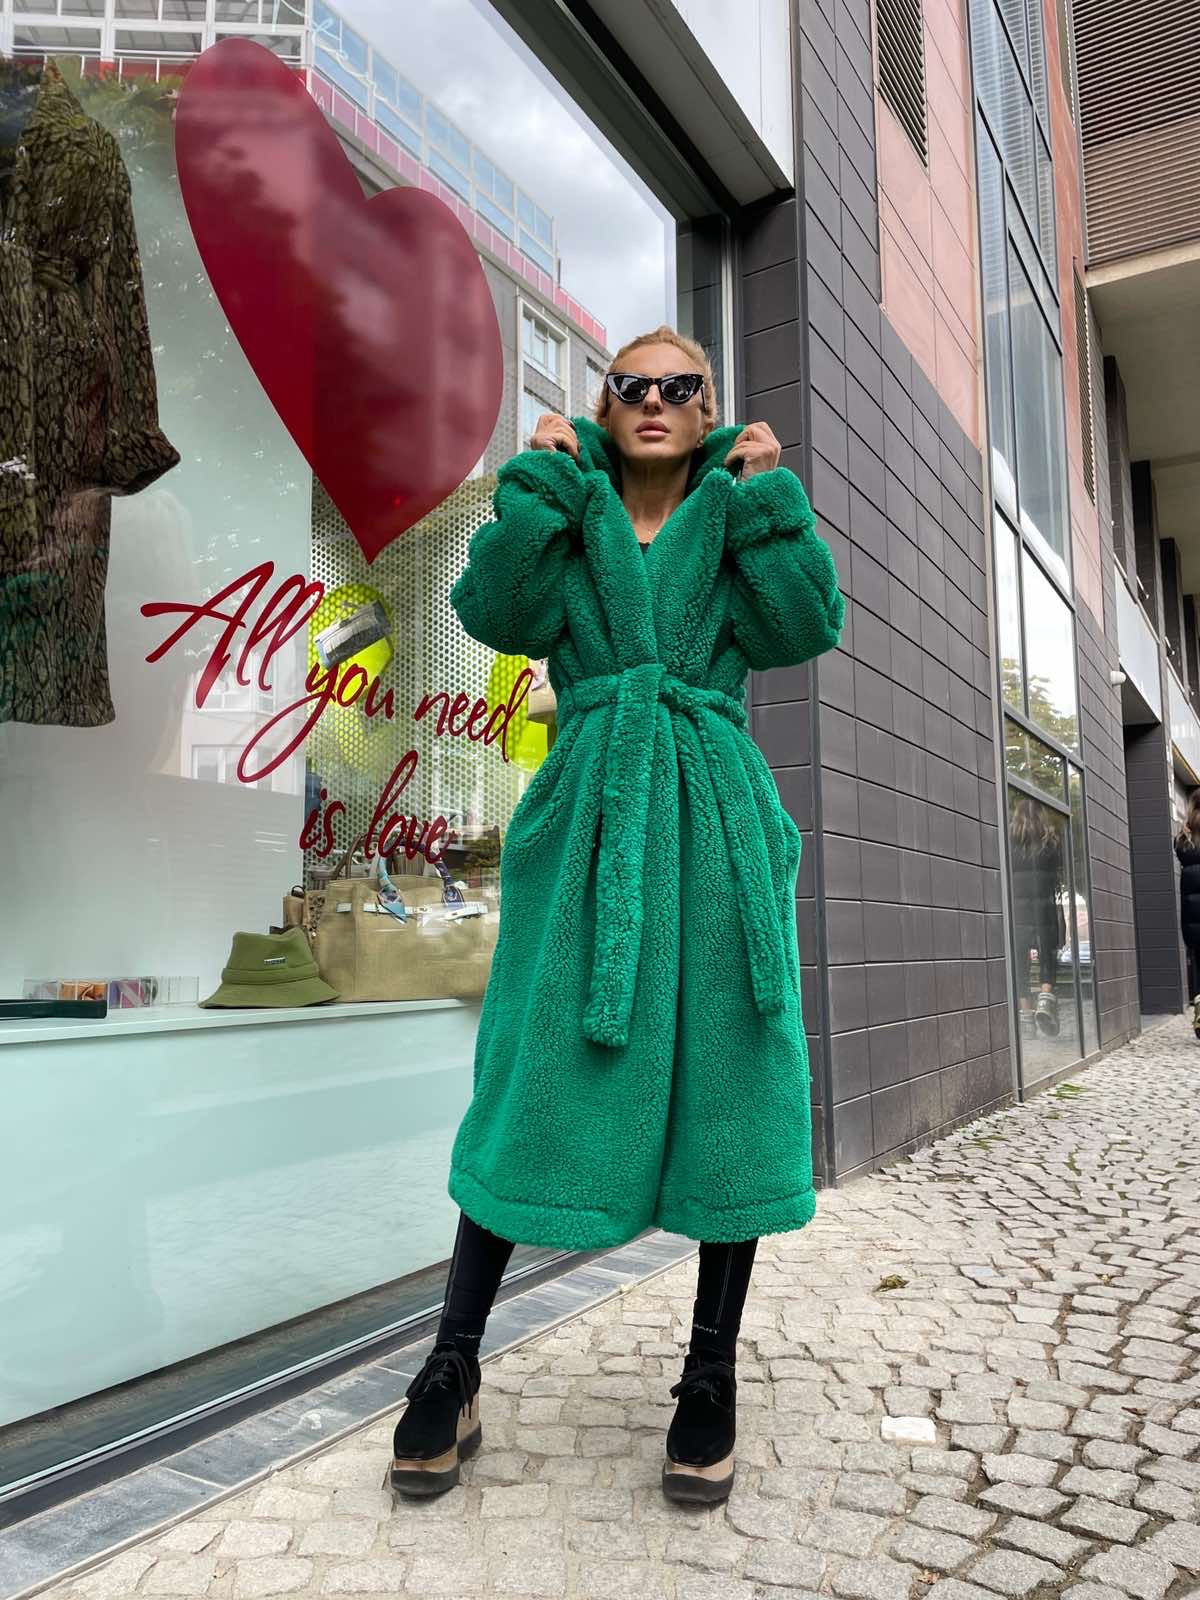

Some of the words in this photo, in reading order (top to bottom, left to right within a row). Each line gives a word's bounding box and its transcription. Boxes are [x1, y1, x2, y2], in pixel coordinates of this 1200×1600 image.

[141, 561, 326, 708] All
[237, 660, 394, 784] you
[414, 667, 535, 764] need
[299, 788, 346, 859] is
[363, 750, 453, 865] love
